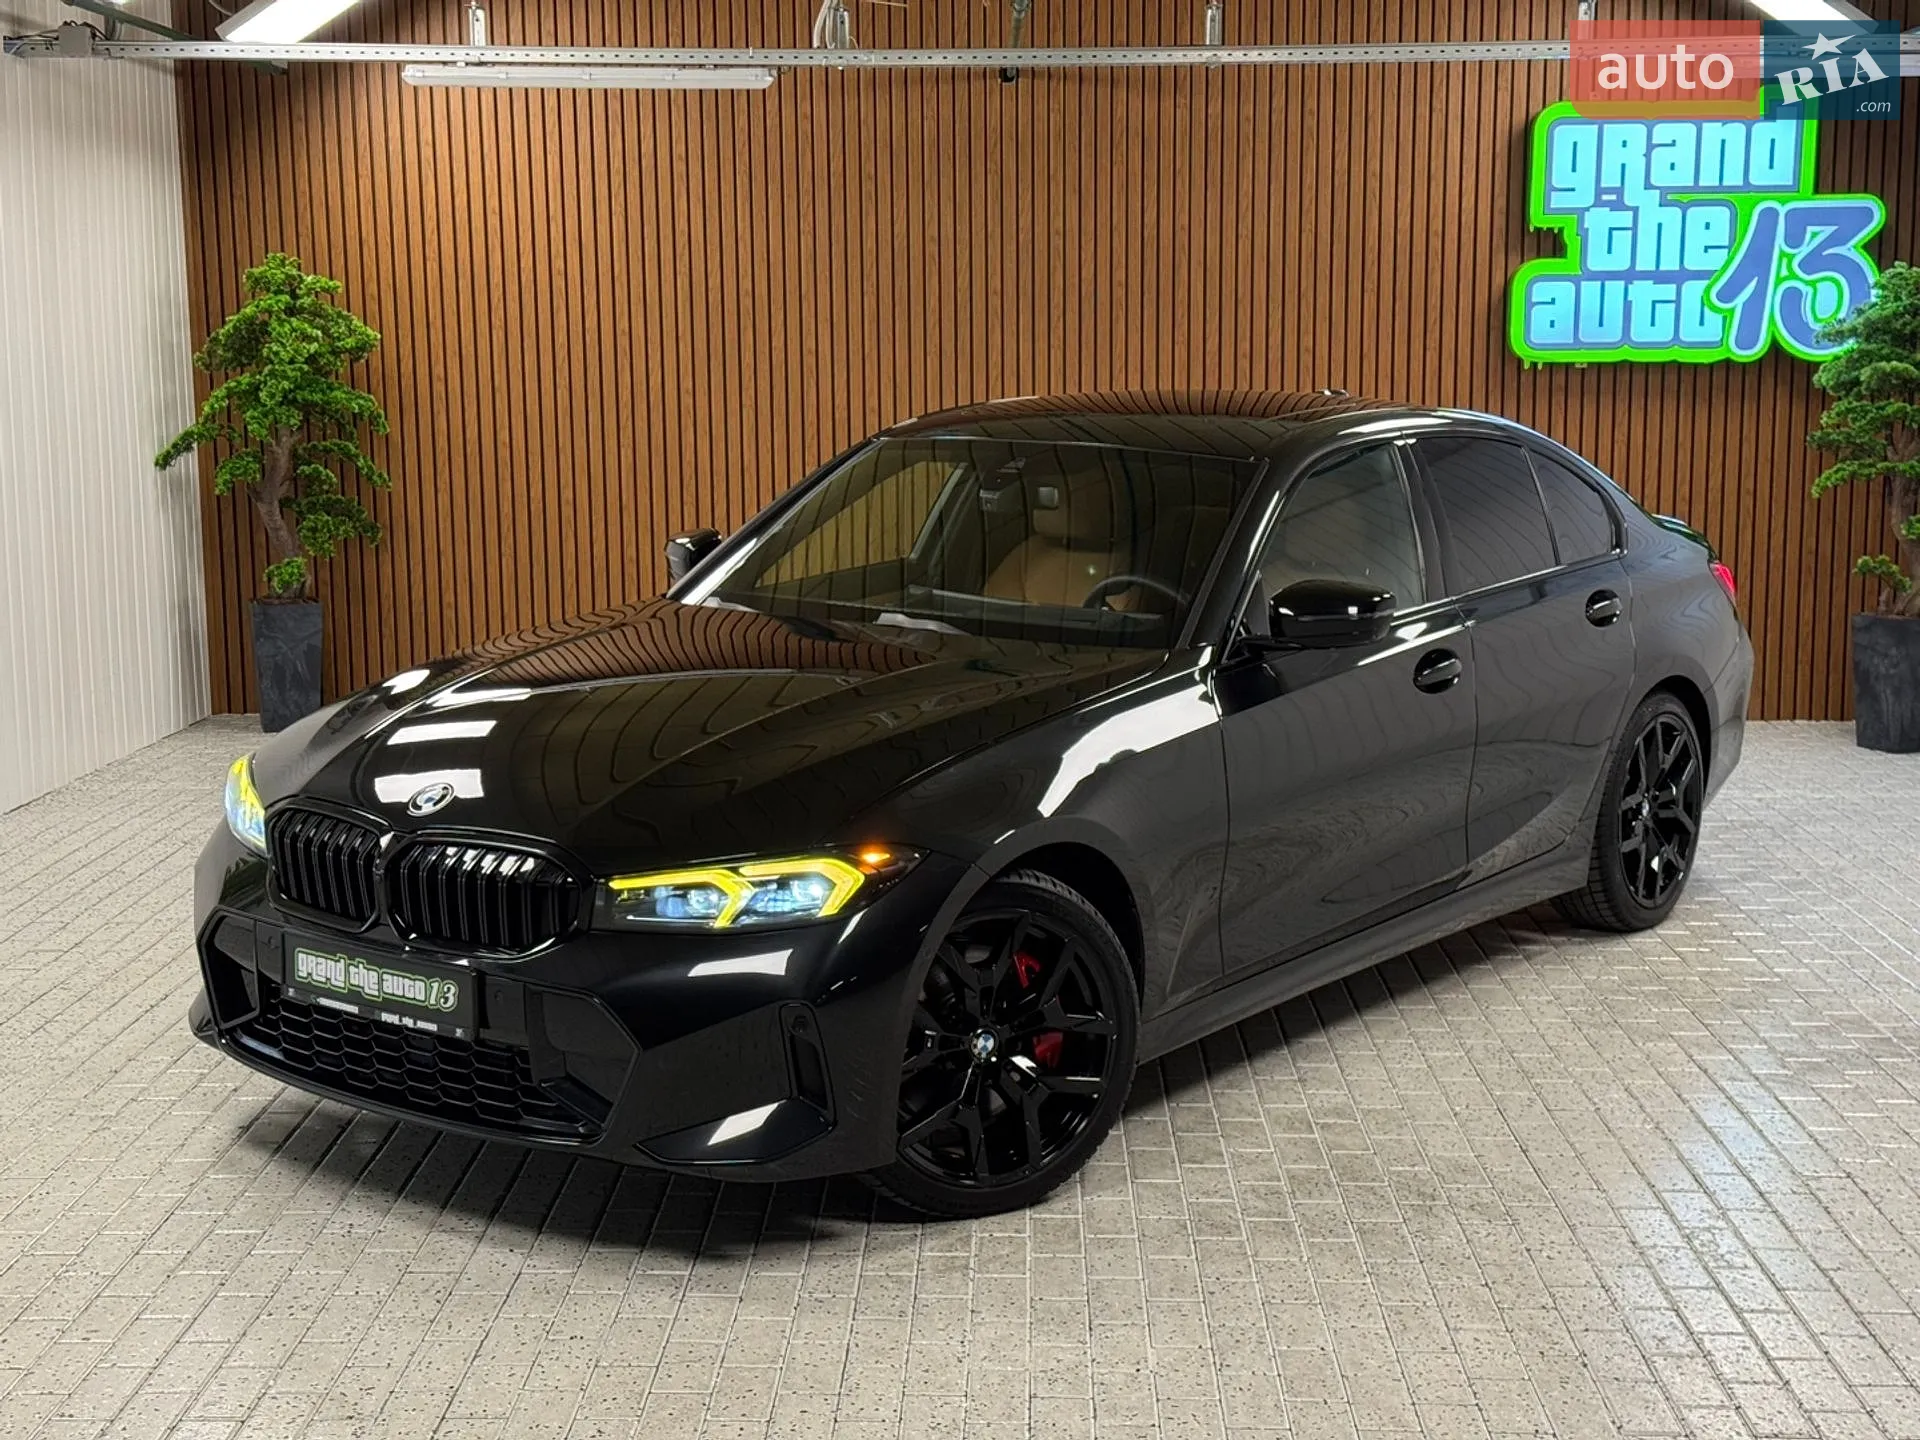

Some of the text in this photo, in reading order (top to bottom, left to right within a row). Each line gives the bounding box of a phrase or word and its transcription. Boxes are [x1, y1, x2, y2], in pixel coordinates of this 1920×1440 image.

[1584, 189, 1731, 272] the
[1711, 203, 1880, 355] 13
[349, 961, 380, 996] the
[382, 972, 426, 1001] auto
[429, 980, 457, 1009] 13
